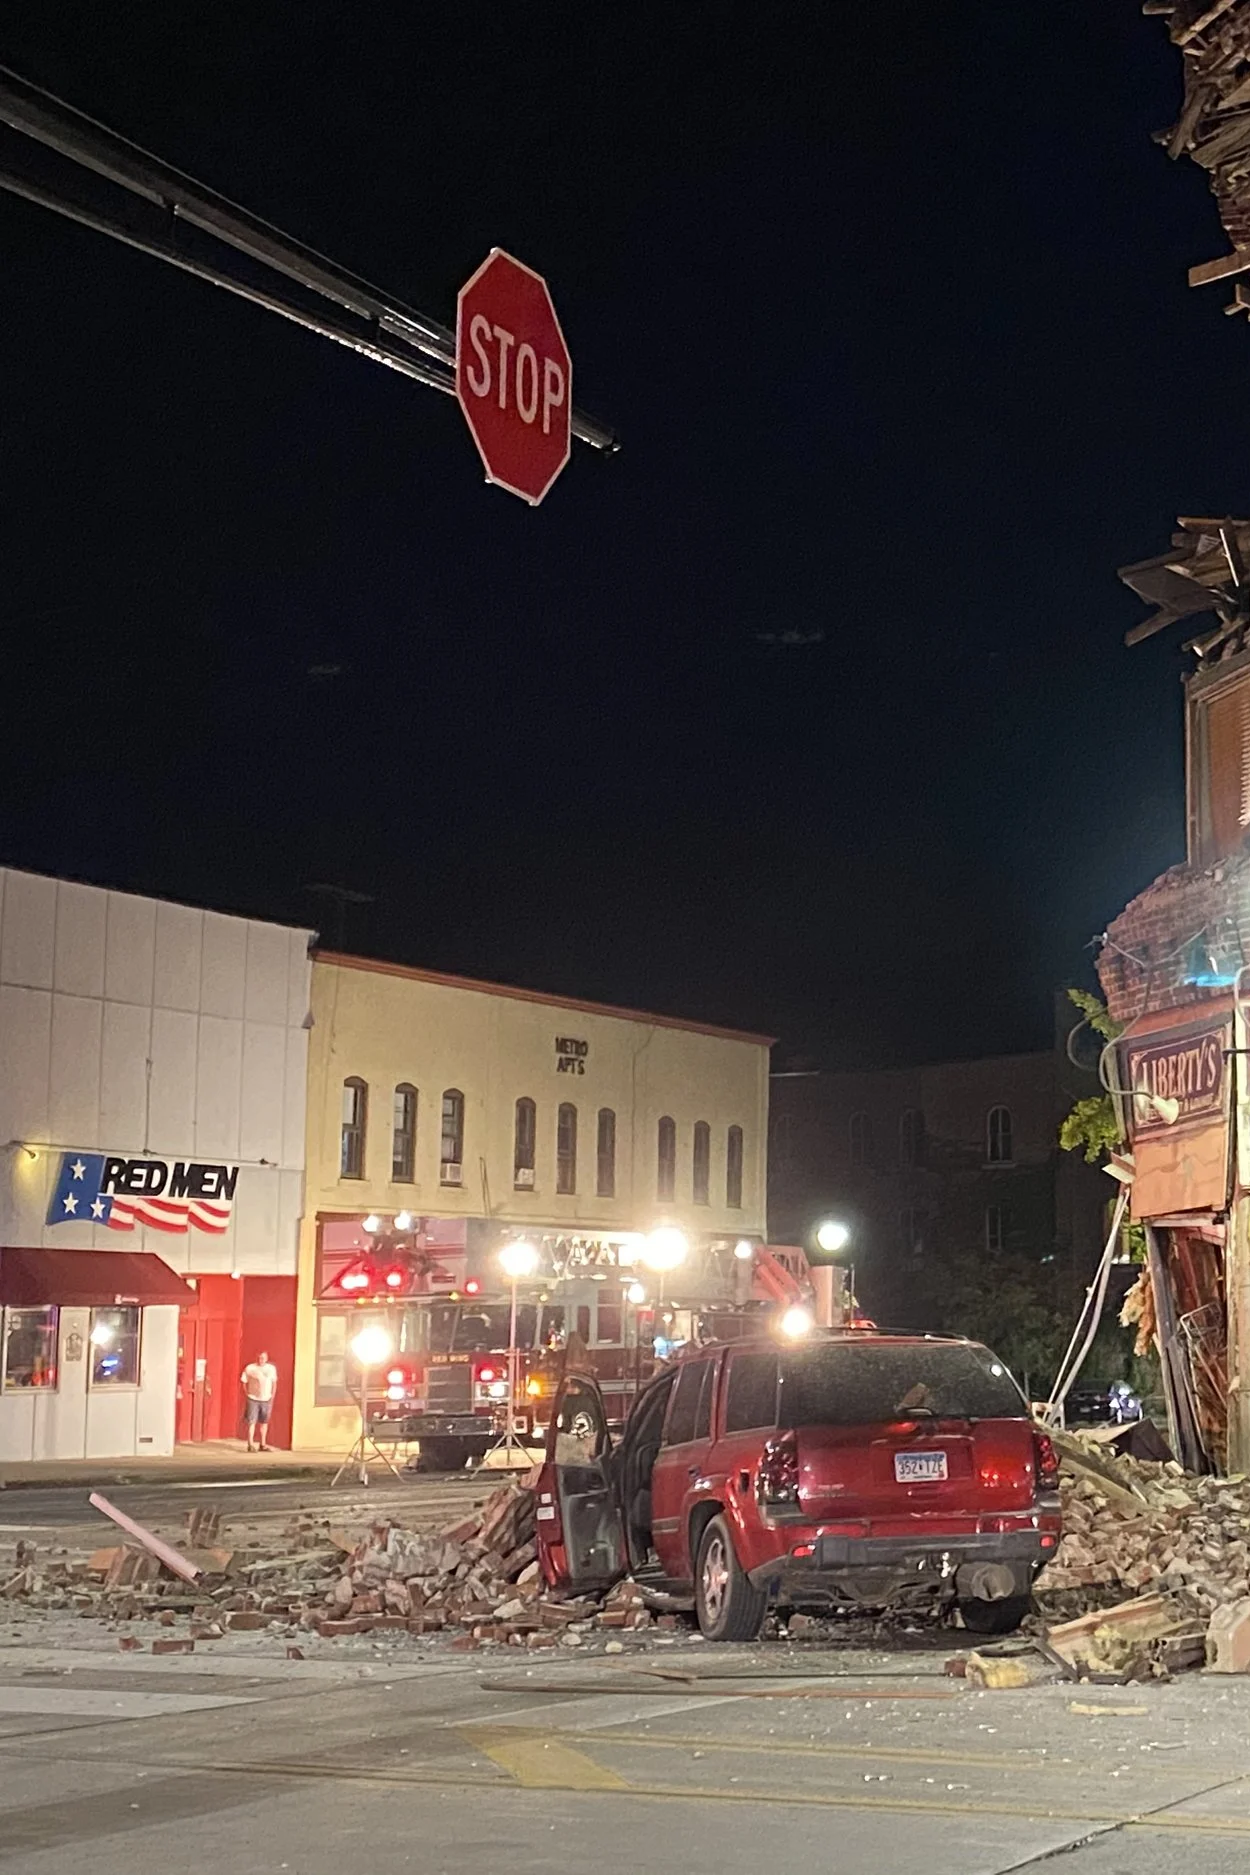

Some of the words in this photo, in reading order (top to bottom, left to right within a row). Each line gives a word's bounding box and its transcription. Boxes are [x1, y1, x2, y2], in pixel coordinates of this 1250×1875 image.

[467, 314, 565, 434] STOP
[555, 1036, 589, 1056] METRO
[1142, 1038, 1217, 1099] LIBERTY'S
[101, 1157, 168, 1196] RED
[168, 1162, 239, 1201] MEN
